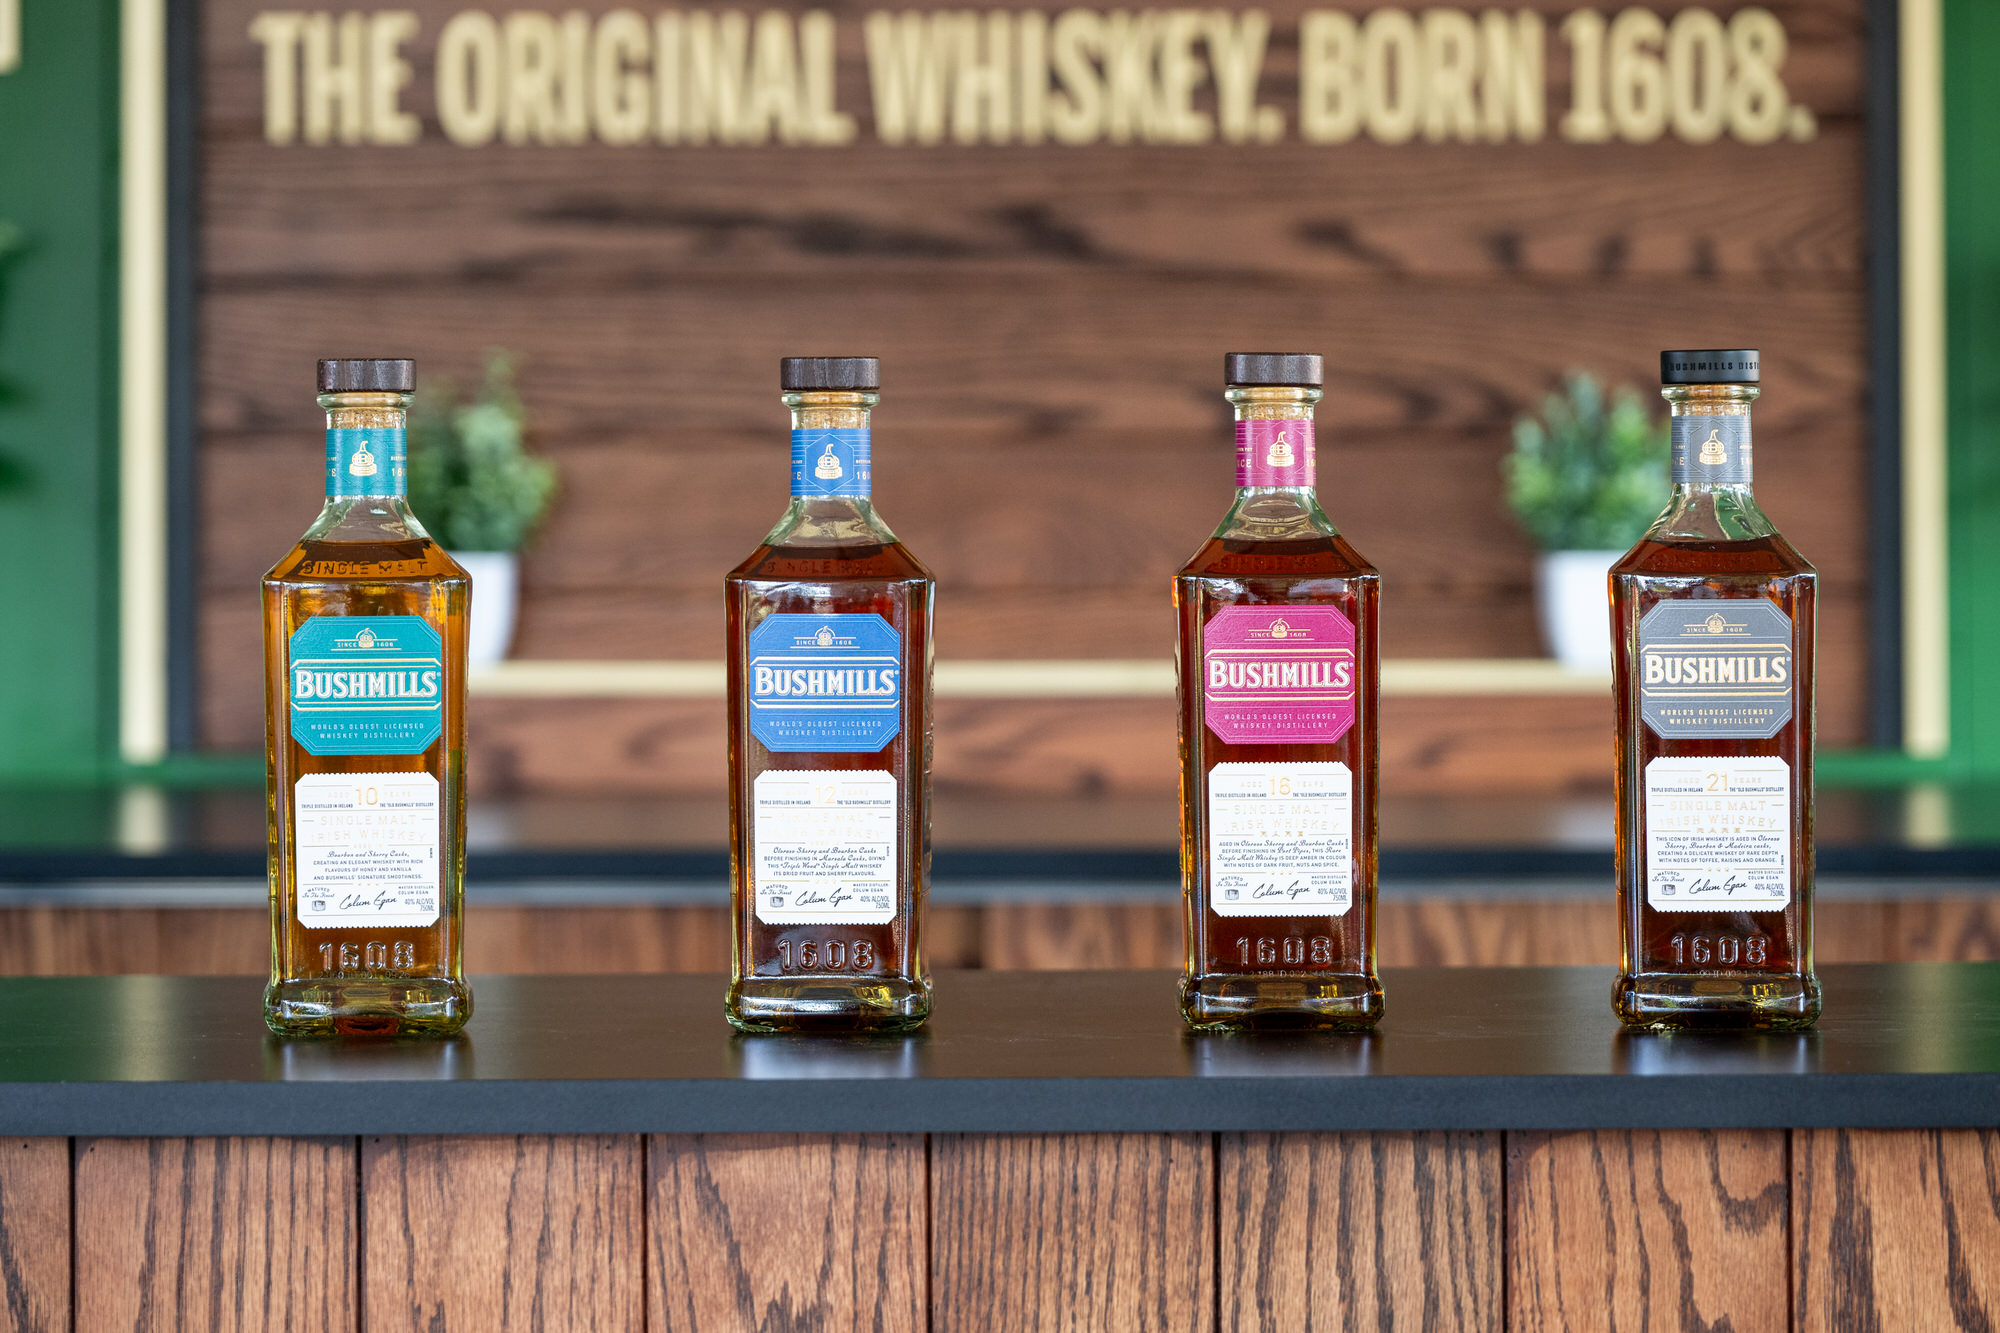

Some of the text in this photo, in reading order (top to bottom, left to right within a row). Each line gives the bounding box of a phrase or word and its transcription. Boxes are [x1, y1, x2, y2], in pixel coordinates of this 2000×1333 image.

[248, 8, 1817, 146] THE ORIGINAL WHISKEY. BORN 1608.
[294, 669, 438, 699] BUSHMILLS
[754, 666, 896, 696] BUSHMILLS
[1208, 659, 1350, 689] BUSHMILLS
[1644, 654, 1787, 684] BUSHMILLS
[356, 786, 378, 805] 10
[1269, 776, 1291, 795] 16
[1706, 773, 1728, 791] 21
[319, 940, 414, 970] 1608
[777, 939, 874, 970] 1608
[1236, 936, 1331, 966] 1608
[1671, 935, 1766, 966] 1608
